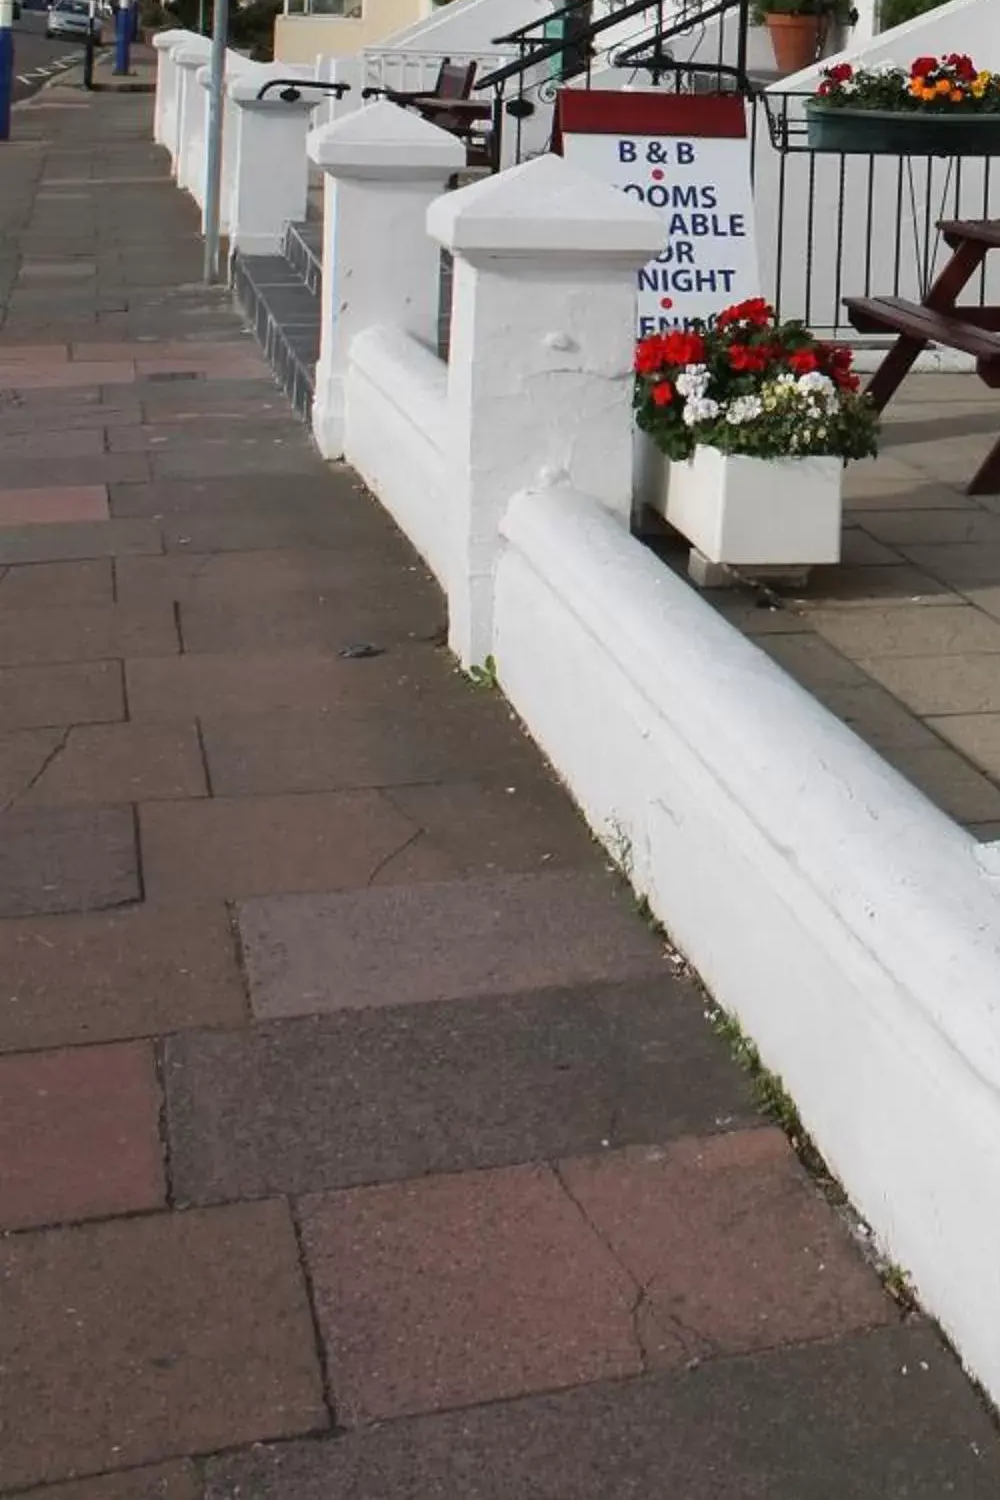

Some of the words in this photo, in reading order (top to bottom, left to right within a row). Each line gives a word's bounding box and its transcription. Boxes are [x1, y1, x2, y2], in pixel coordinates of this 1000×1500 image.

[619, 141, 637, 163] B
[646, 142, 668, 164] &
[676, 143, 695, 165] B
